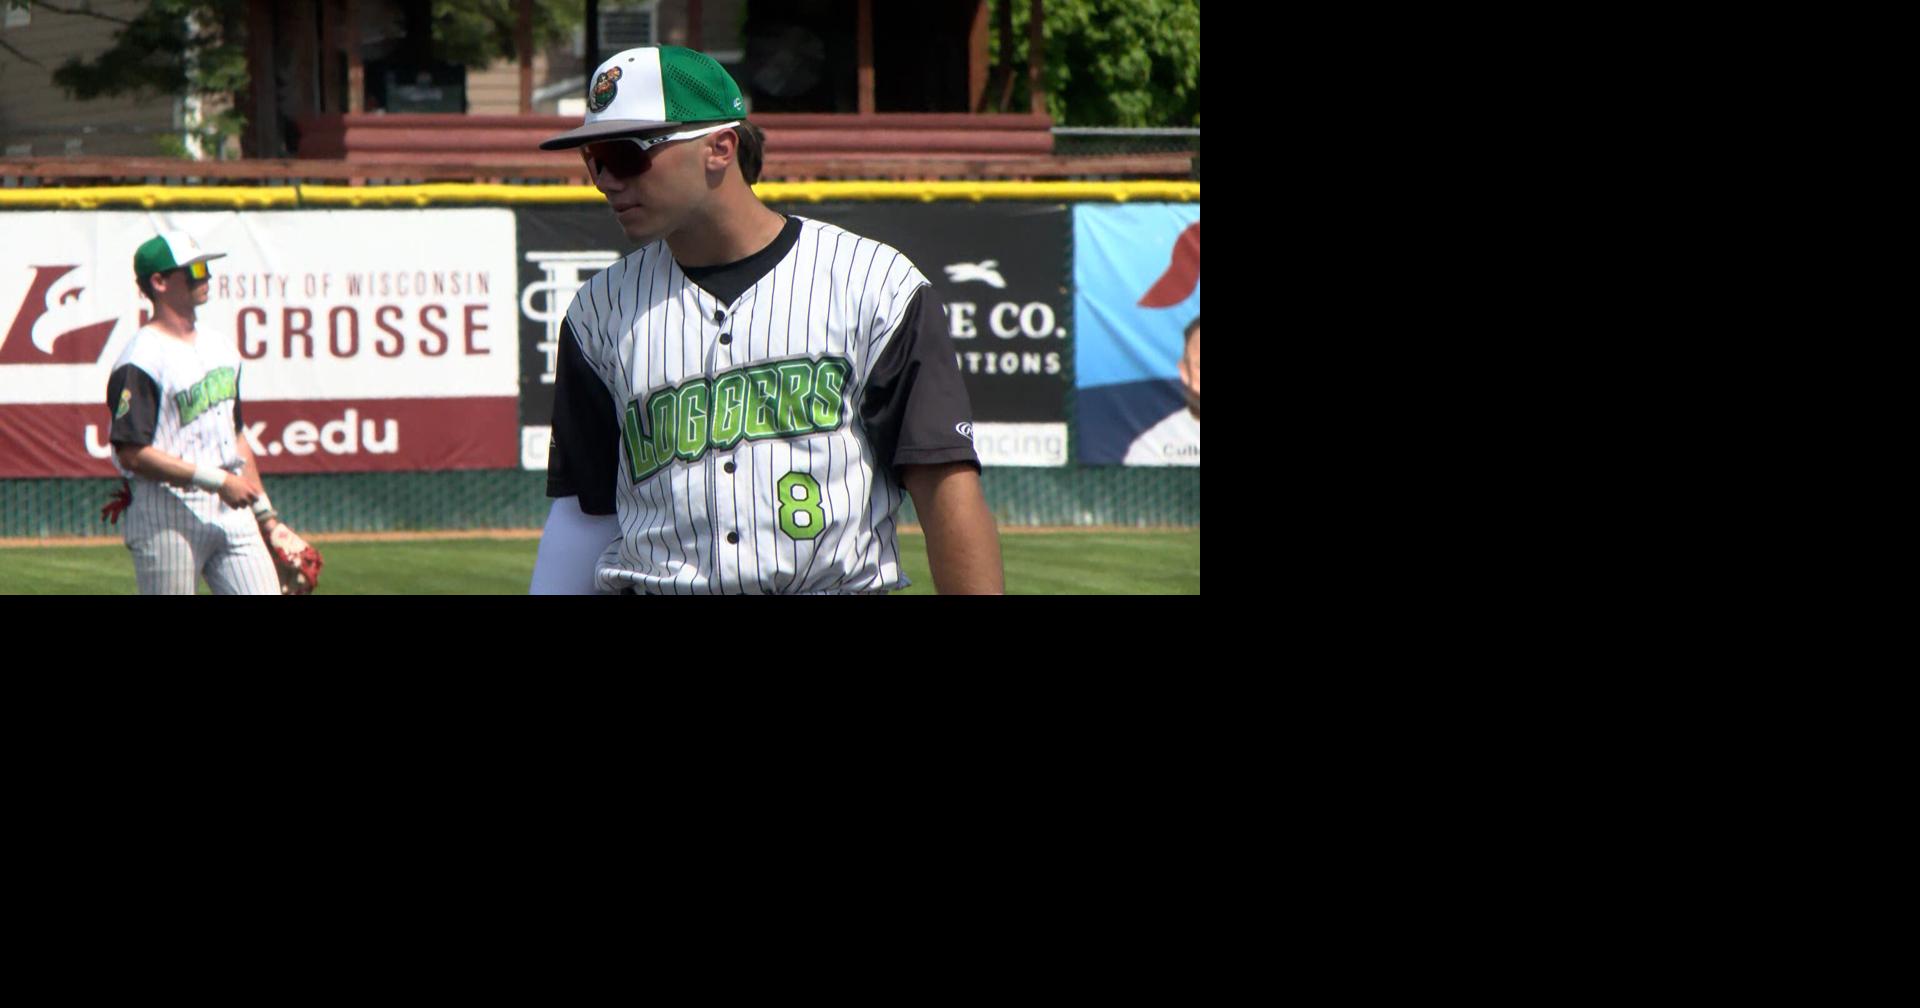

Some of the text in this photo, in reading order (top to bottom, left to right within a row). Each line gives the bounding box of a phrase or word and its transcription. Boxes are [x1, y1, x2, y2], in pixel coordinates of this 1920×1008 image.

[219, 270, 491, 299] RSITY OF WISCONSIN
[236, 304, 491, 360] CROSSE
[989, 301, 1067, 339] CO.
[85, 408, 399, 458] ux.edu
[622, 354, 853, 487] LOGGERS
[977, 432, 1061, 460] ncing
[777, 471, 826, 541] 8
